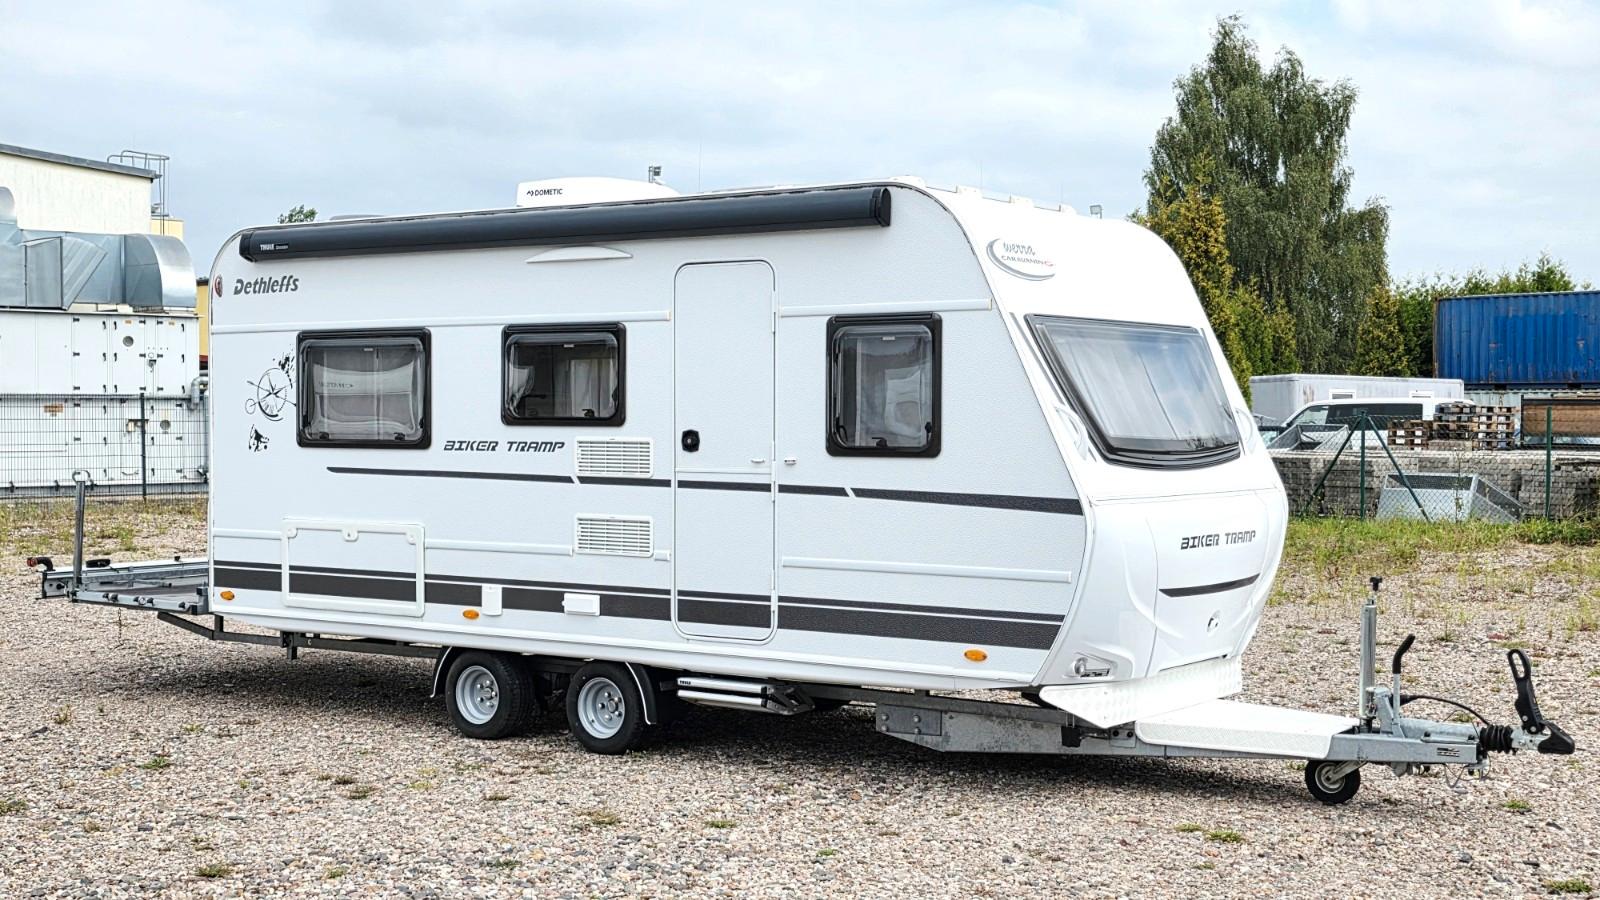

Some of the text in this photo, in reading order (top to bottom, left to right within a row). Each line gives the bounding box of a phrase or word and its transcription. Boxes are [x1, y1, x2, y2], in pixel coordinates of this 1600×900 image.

[534, 188, 563, 197] DOMETIC
[260, 243, 275, 251] THULE
[233, 274, 300, 295] Dethleffs
[443, 440, 566, 453] BIKER TRAMP
[1180, 529, 1256, 550] BIKER TRAMP
